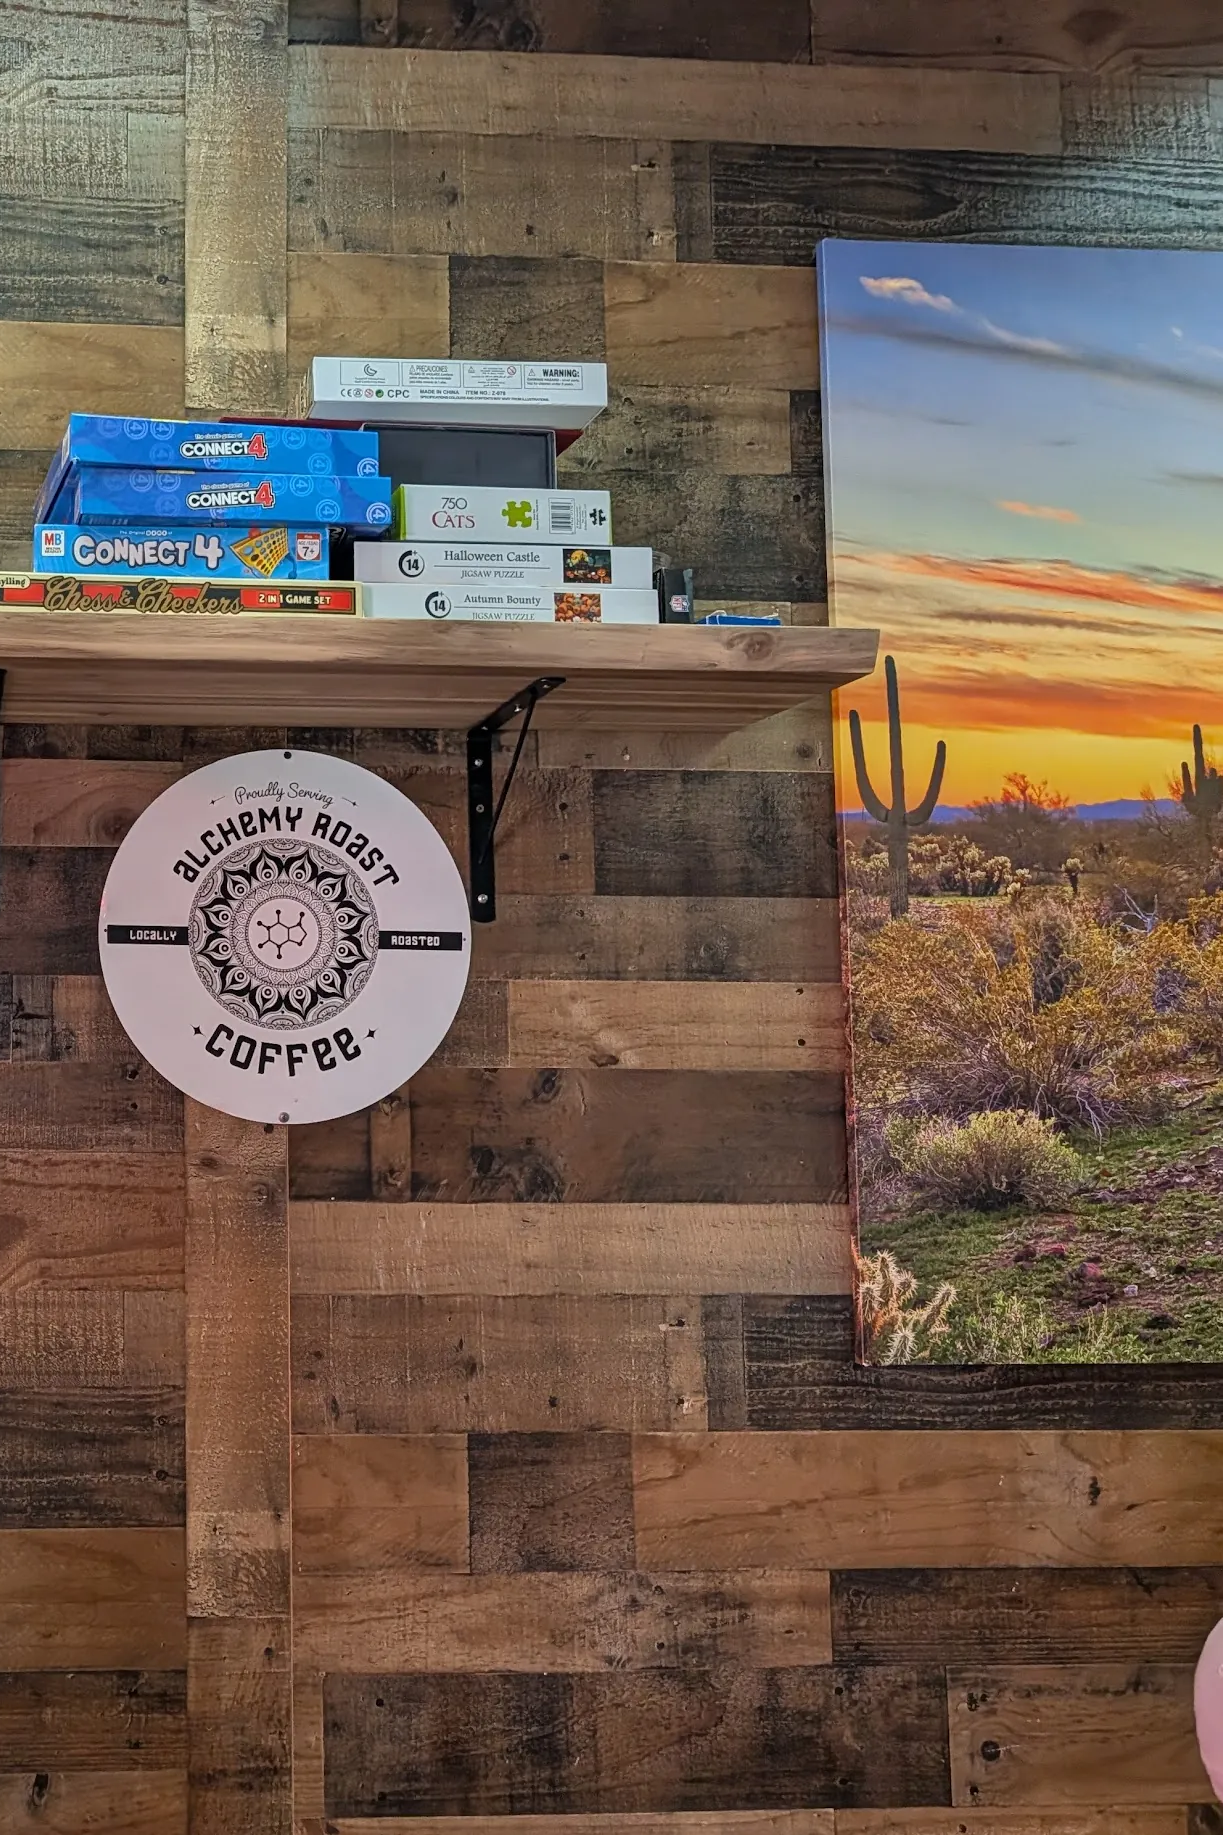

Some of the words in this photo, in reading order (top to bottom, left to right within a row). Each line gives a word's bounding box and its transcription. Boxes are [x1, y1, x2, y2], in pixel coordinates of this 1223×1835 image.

[542, 369, 580, 378] WARNING:
[387, 390, 410, 399] CPC
[181, 442, 249, 457] CONNECT
[248, 434, 267, 459] 4
[188, 491, 256, 507] CONNECT
[254, 482, 274, 508] 4
[441, 498, 468, 510] 750
[44, 533, 62, 546] MB
[73, 534, 190, 566] CONNECT
[193, 533, 225, 570] 4
[302, 546, 315, 557] 7+
[444, 550, 504, 562] Halloween
[509, 552, 540, 563] Castle
[461, 570, 491, 579] JIGSAW
[493, 571, 525, 579] PUZZLE
[43, 576, 117, 612] Chess
[119, 590, 134, 606] &
[134, 578, 244, 614] Checkers
[259, 594, 266, 603] 2
[268, 594, 276, 603] IN
[285, 594, 312, 604] GAME
[313, 596, 332, 605] SET
[464, 594, 504, 604] Autumn
[507, 596, 541, 607] Bounty
[473, 612, 502, 620] JIGSAW
[504, 613, 535, 621] PUZZLE
[234, 782, 285, 804] Proudly
[287, 783, 334, 806] Serving
